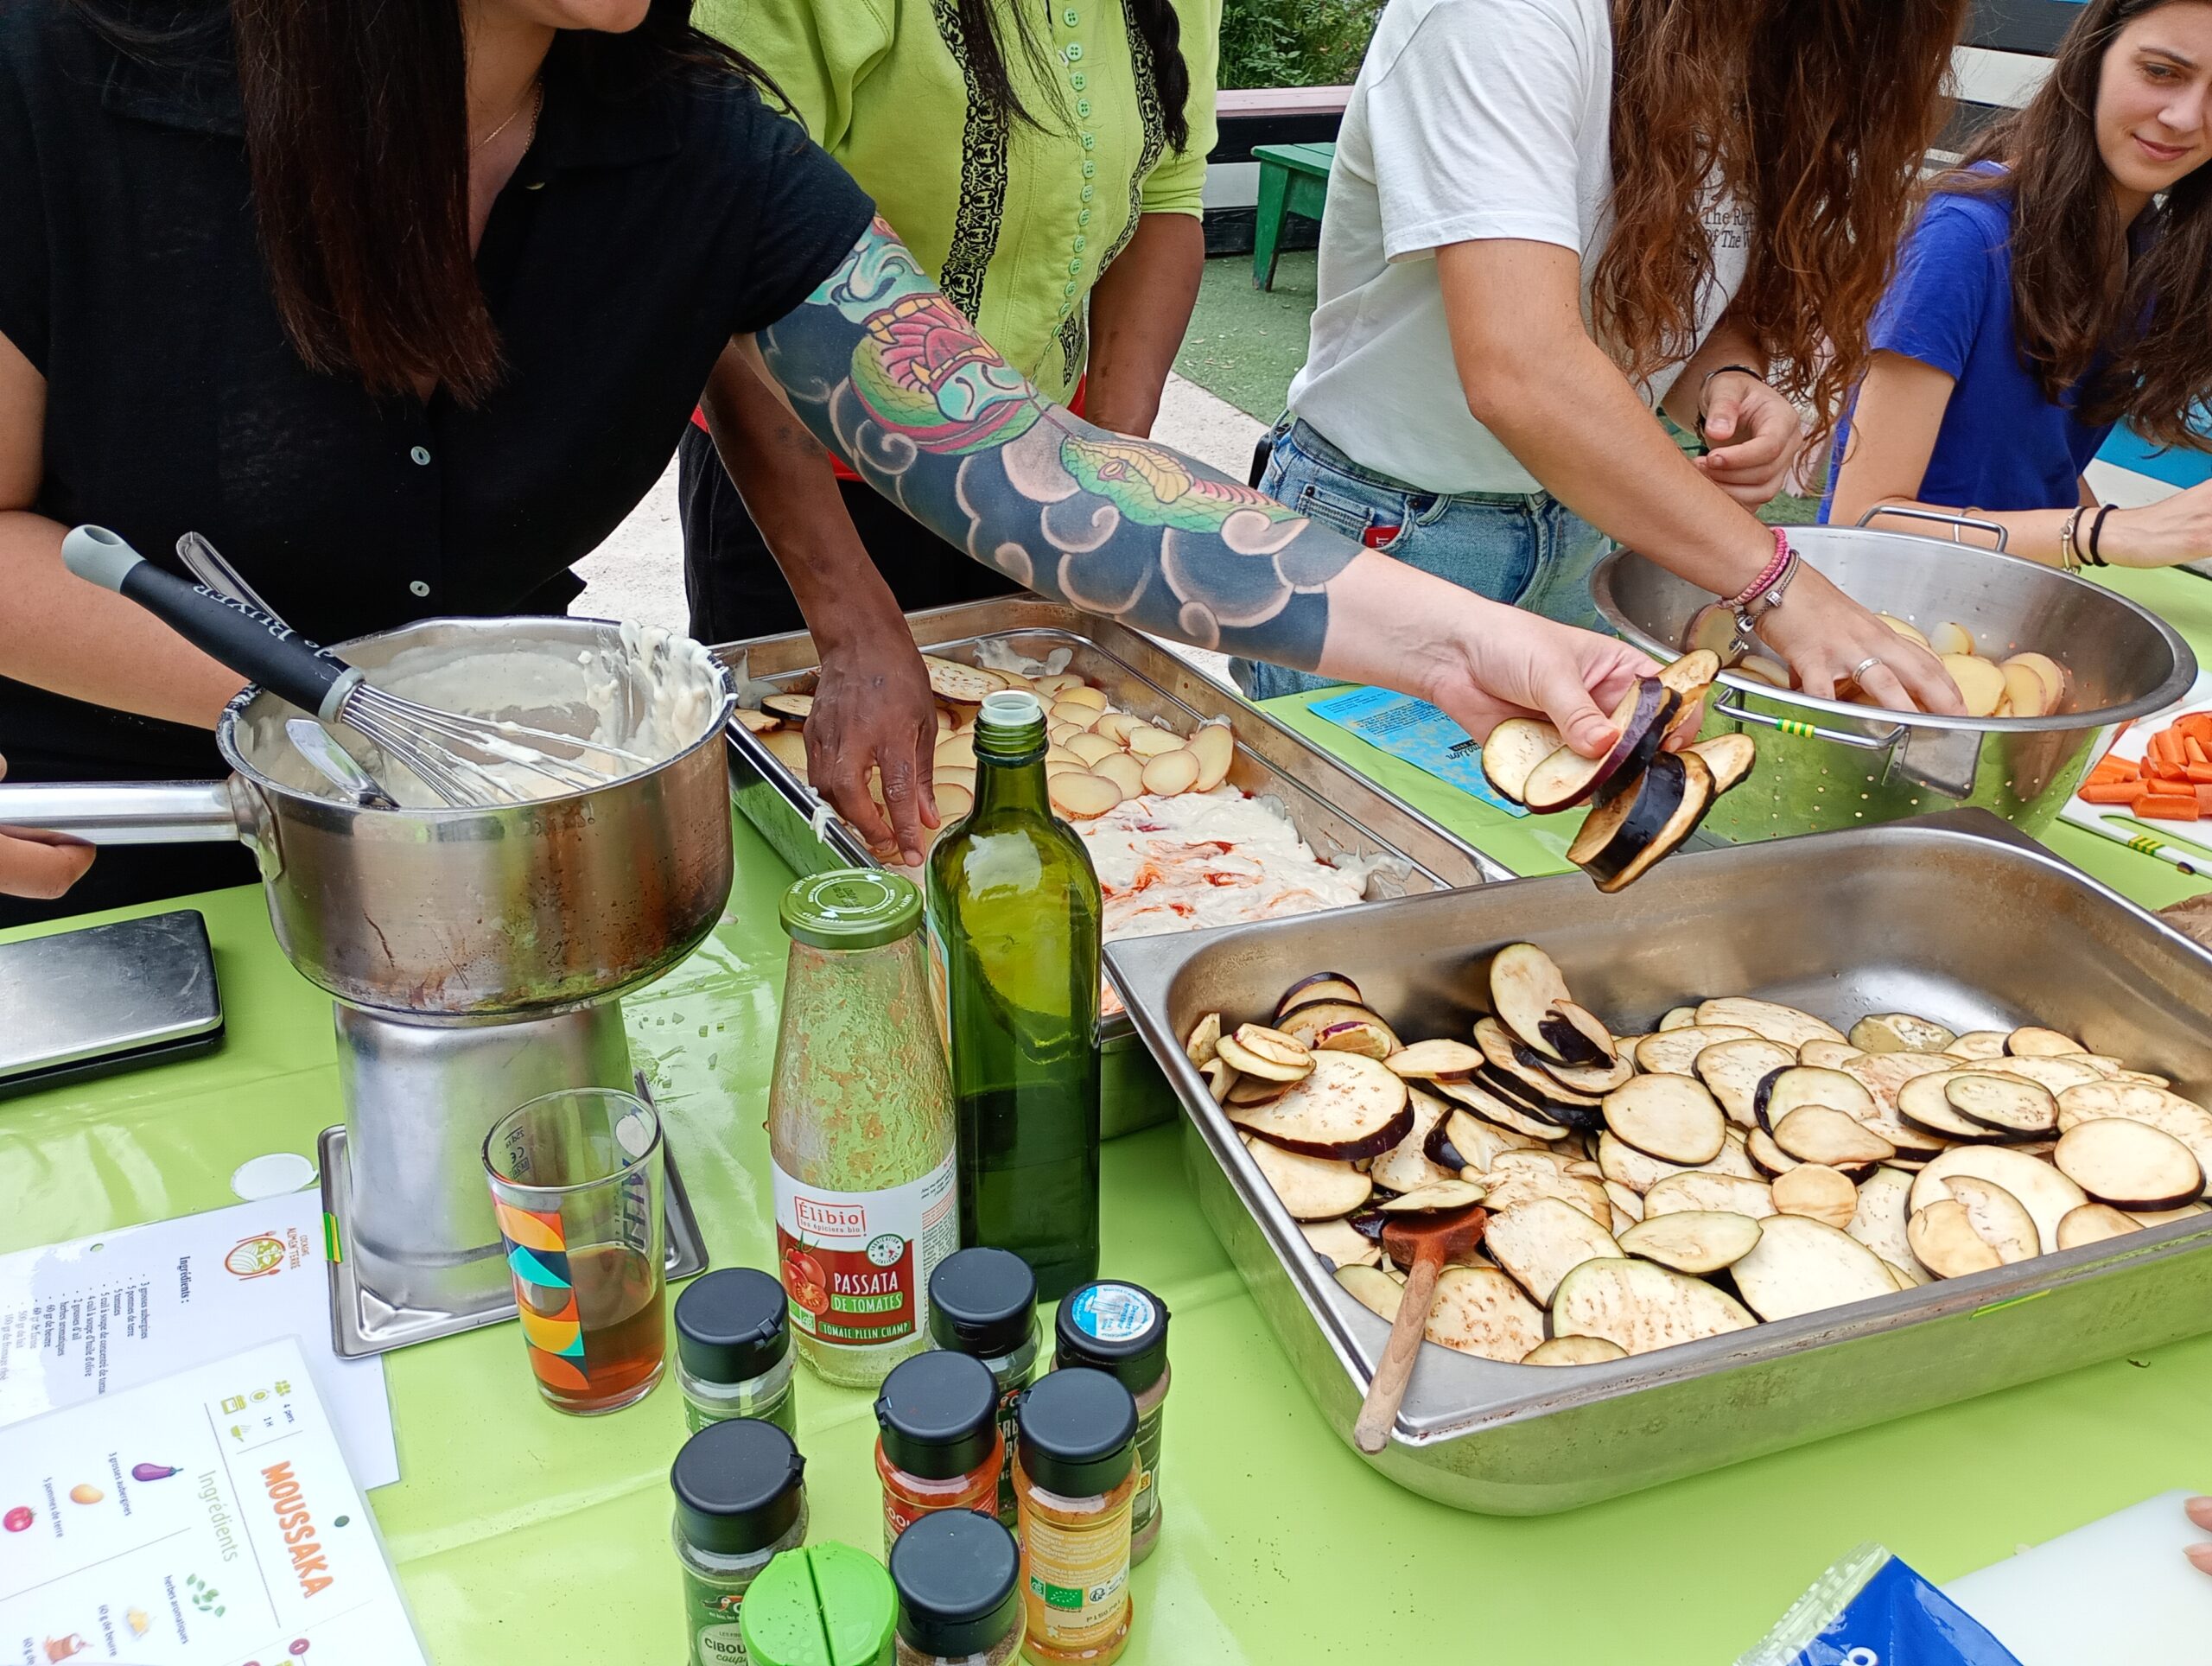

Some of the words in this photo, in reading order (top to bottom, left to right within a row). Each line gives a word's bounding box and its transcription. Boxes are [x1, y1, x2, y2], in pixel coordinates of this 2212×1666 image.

[1702, 207, 1730, 225] The
[1721, 230, 1741, 248] The
[177, 1256, 192, 1299] Ingrédients
[834, 1270, 899, 1295] PASSATA
[834, 1296, 847, 1312] DE
[851, 1294, 902, 1313] TOMATES
[127, 1314, 137, 1323] de
[100, 1331, 109, 1339] de
[855, 1327, 879, 1339] PLEIN
[881, 1322, 908, 1338] CHAMP
[198, 1470, 238, 1562] Ingrédients
[261, 1460, 334, 1599] MOUSSAKA
